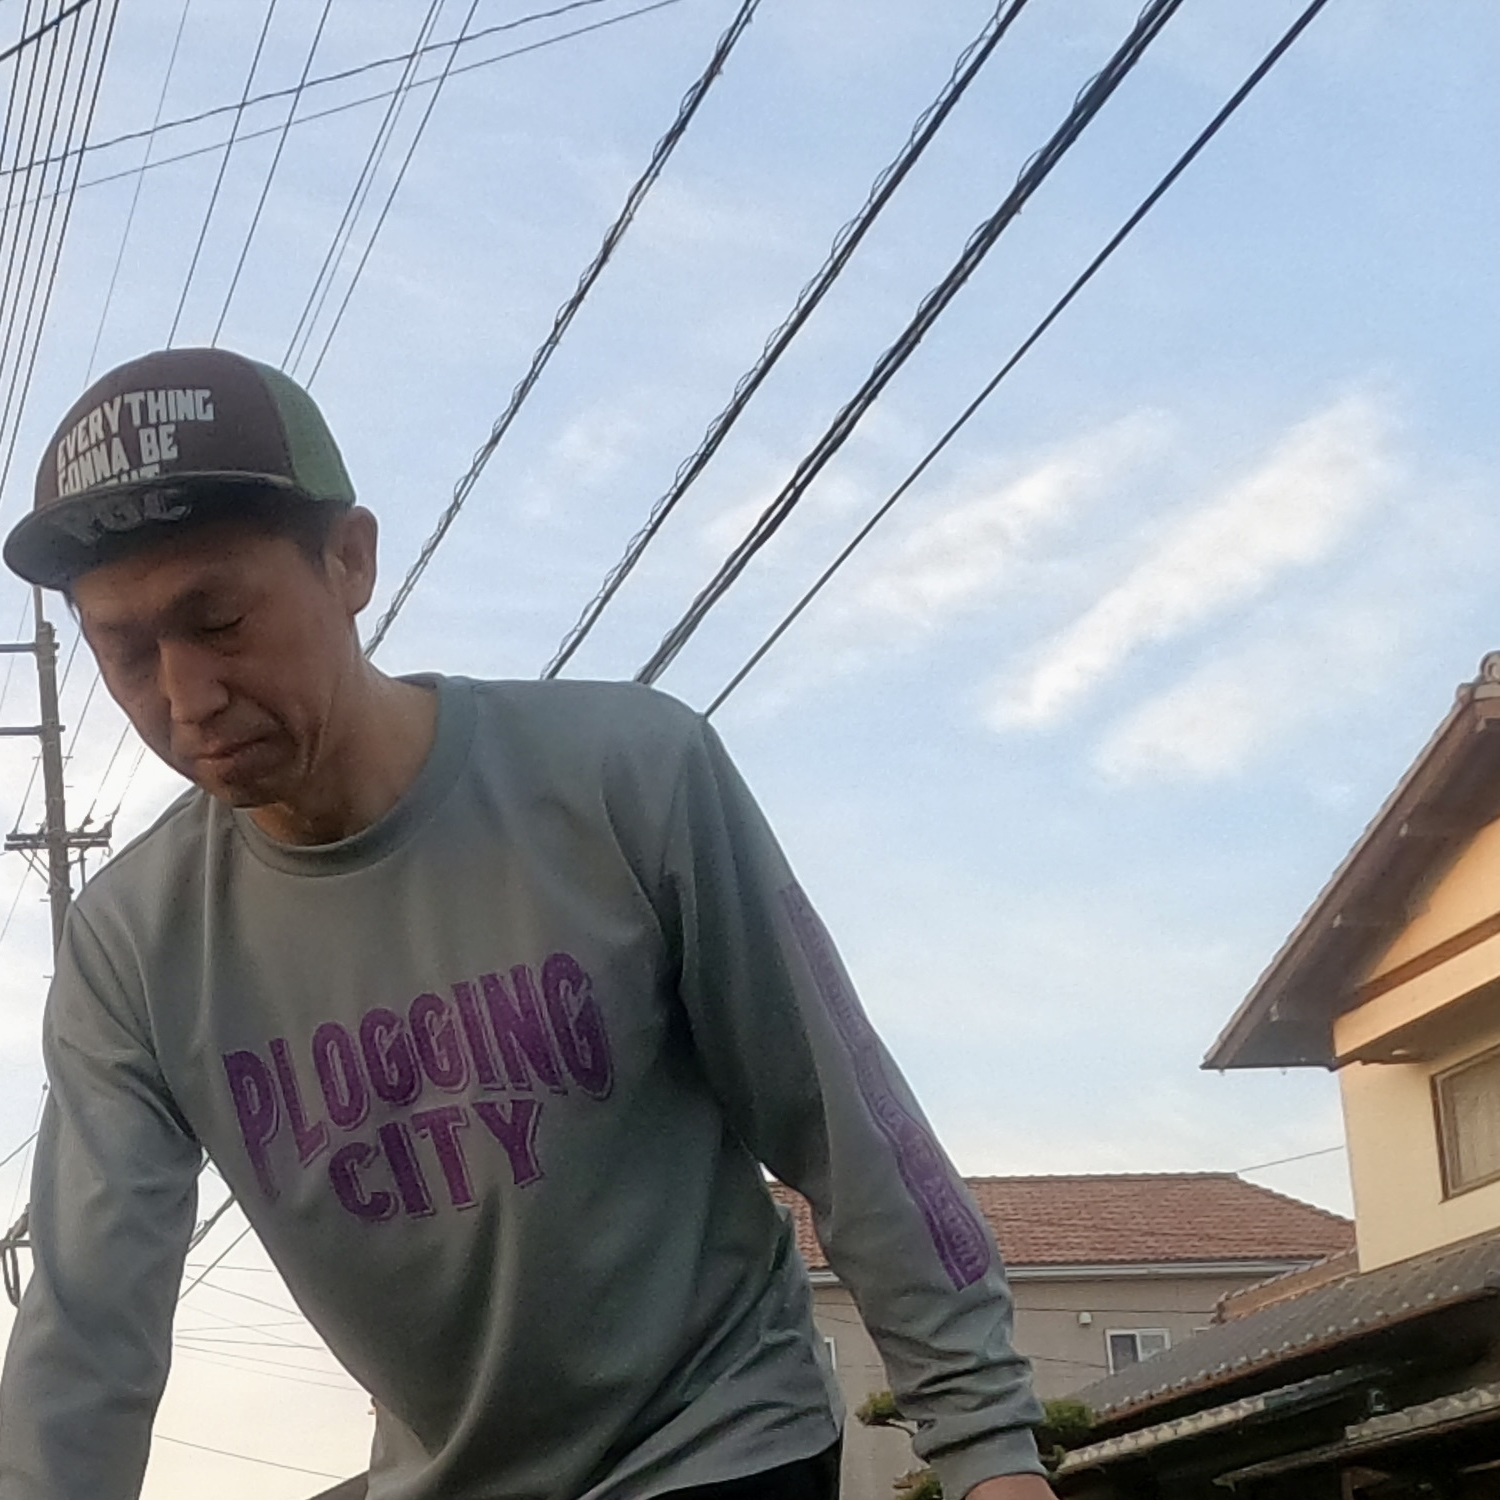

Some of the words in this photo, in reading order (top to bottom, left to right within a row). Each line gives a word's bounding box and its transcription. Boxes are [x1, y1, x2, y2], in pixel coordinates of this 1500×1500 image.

[56, 387, 215, 472] EVERYTHING
[57, 436, 130, 498] GONNA
[138, 423, 179, 465] BE
[222, 952, 614, 1200] PLOGGING
[328, 1099, 544, 1220] CITY
